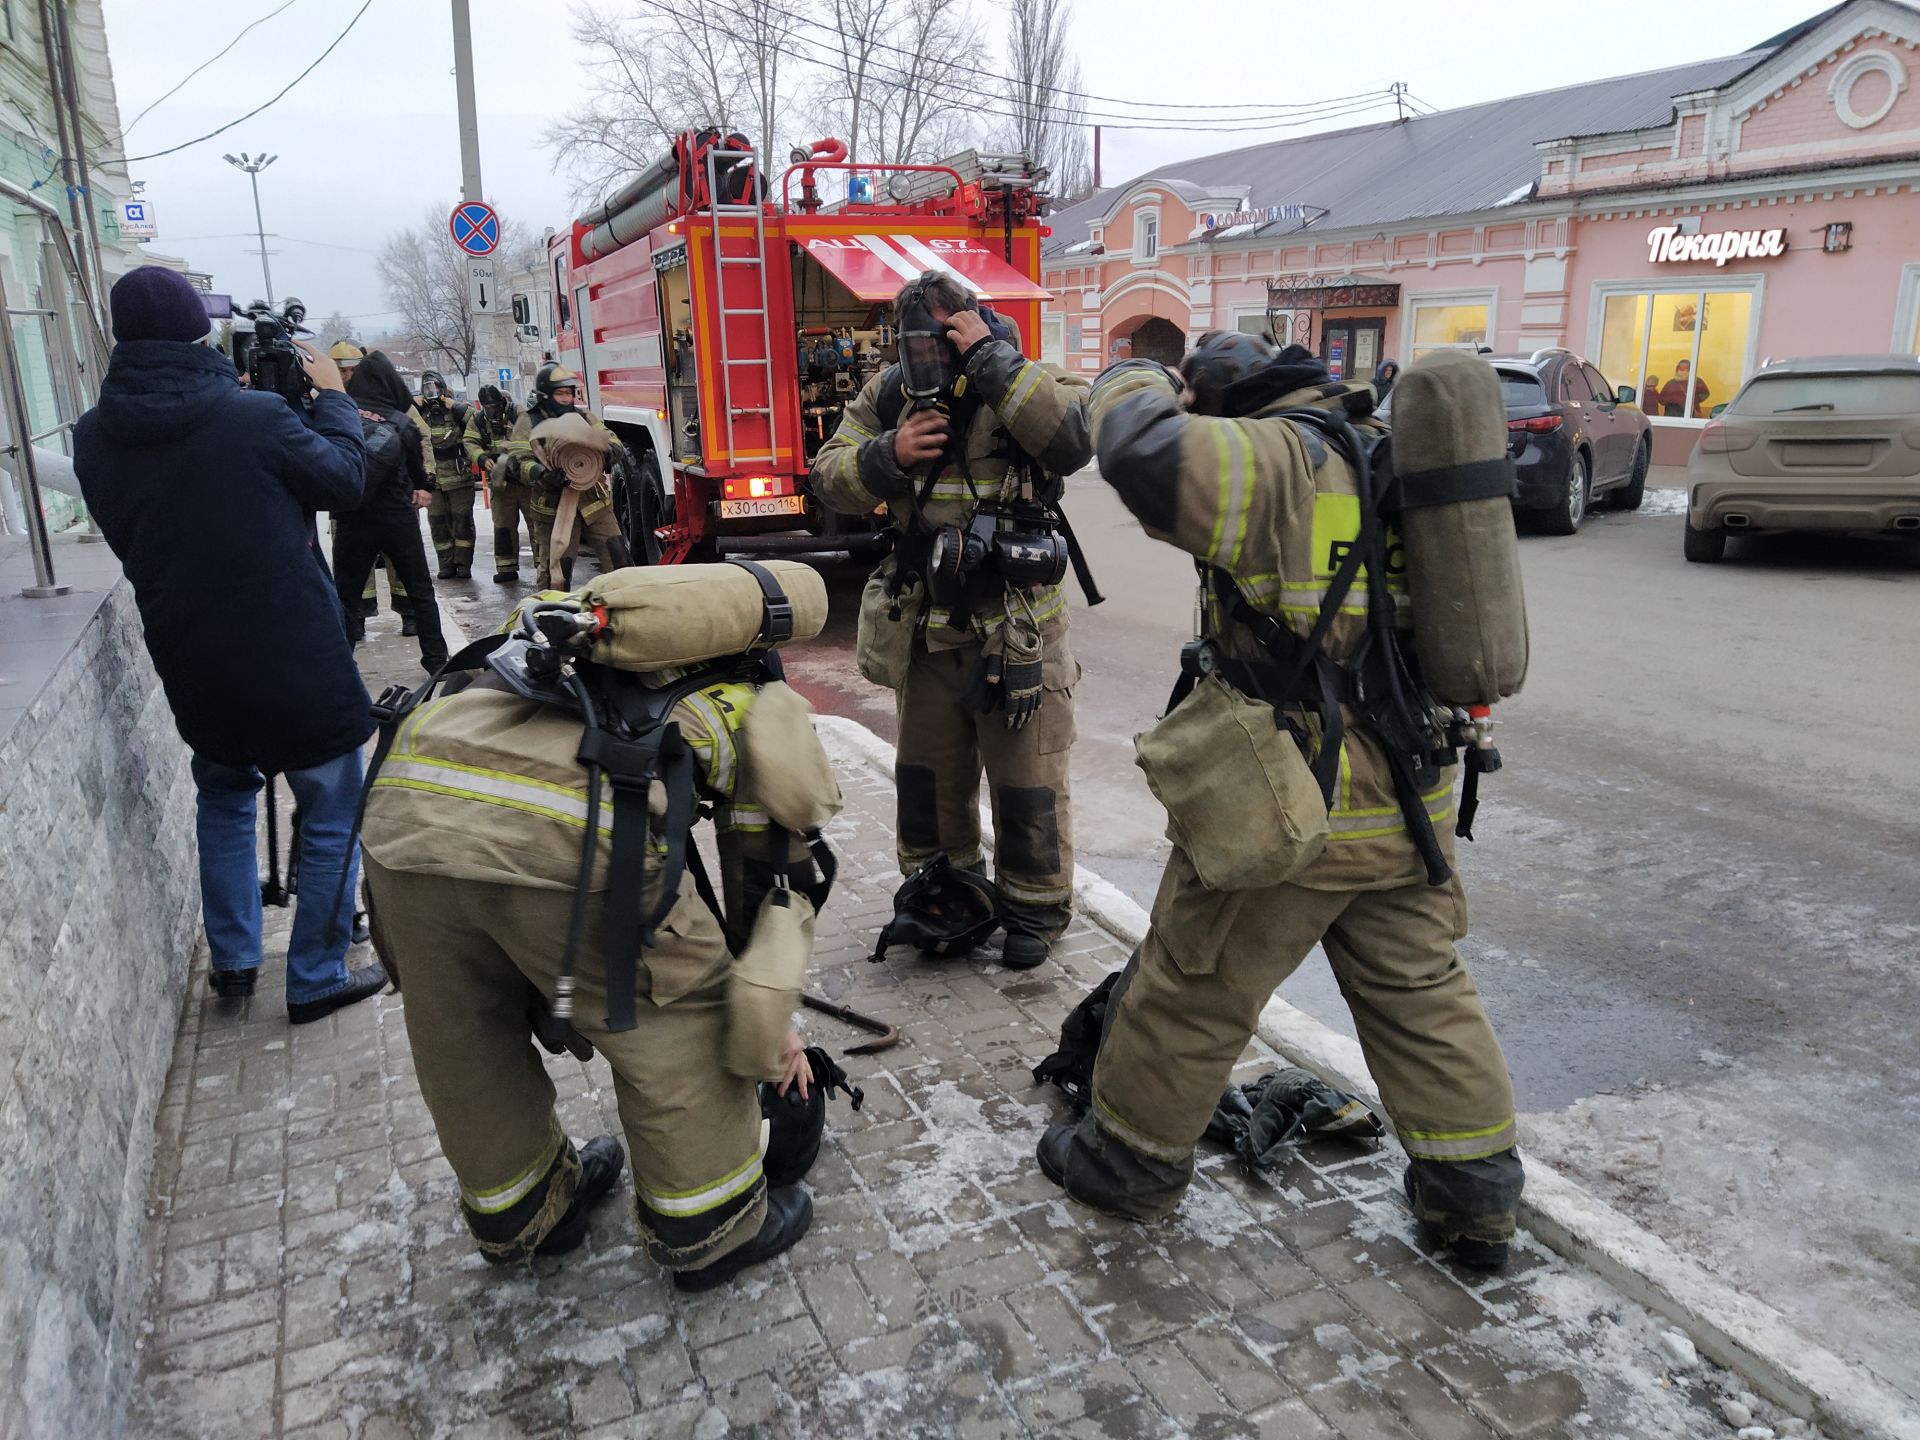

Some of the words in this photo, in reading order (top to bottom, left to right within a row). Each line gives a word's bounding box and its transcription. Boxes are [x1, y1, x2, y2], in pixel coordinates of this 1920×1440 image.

[1216, 204, 1305, 228] СОВКОМБАНК
[808, 239, 869, 250] АЦ
[929, 239, 968, 249] 67
[1647, 226, 1785, 267] Пекарня
